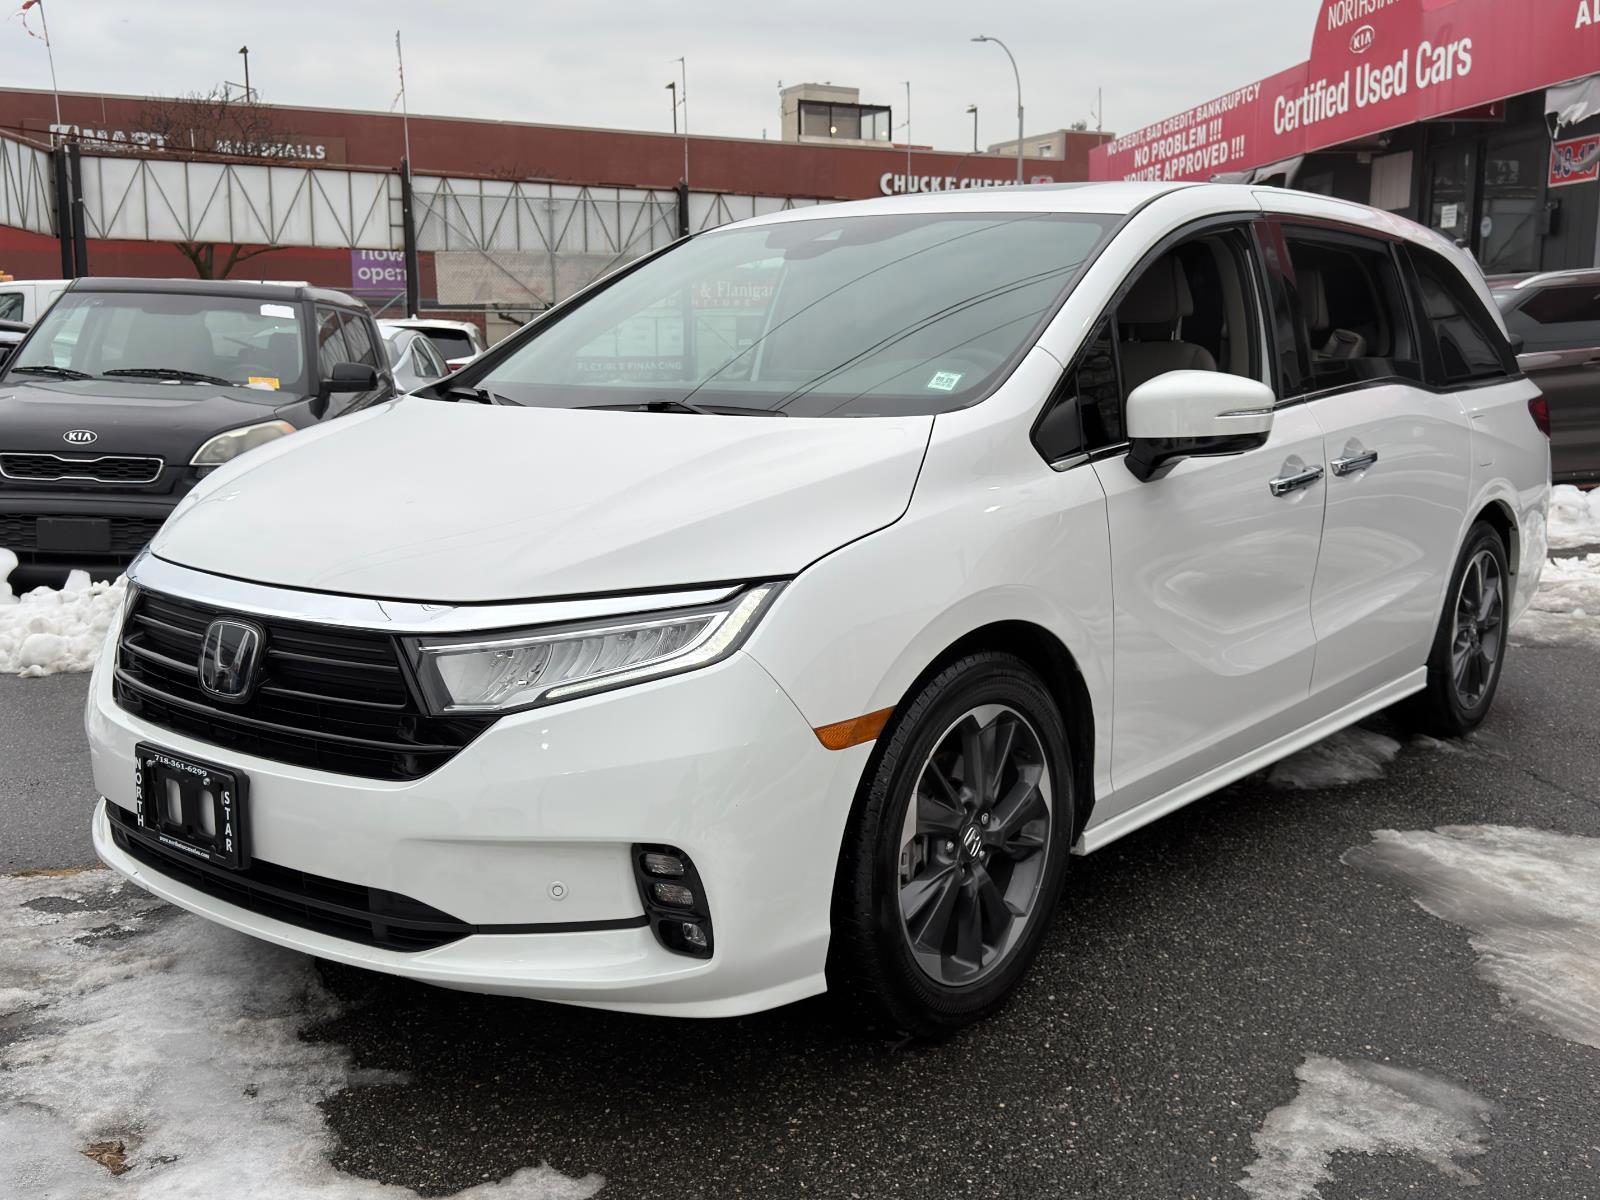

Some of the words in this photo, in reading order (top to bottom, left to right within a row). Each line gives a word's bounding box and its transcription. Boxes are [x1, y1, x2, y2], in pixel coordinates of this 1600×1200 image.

[1327, 0, 1398, 31] NORTHS
[1274, 70, 1350, 135] Certified
[1355, 49, 1408, 108] Used
[1416, 37, 1472, 89] Cars
[1107, 139, 1117, 156] NO
[1146, 124, 1162, 141] BAD
[1163, 111, 1195, 135] CREDIT,
[1196, 82, 1261, 120] BANKRUPTCY
[1134, 148, 1149, 168] NO
[1151, 125, 1207, 162] PROBLEM
[1209, 118, 1222, 142] !!!
[1163, 141, 1228, 181] APPROVED
[1232, 135, 1245, 160] !!!
[880, 172, 942, 195] CHUCK
[361, 250, 404, 261] now
[358, 267, 407, 284] open
[68, 431, 92, 441] KIA
[154, 754, 208, 777] 718-361-6299
[135, 757, 145, 828] NORTH
[224, 791, 233, 853] STAR
